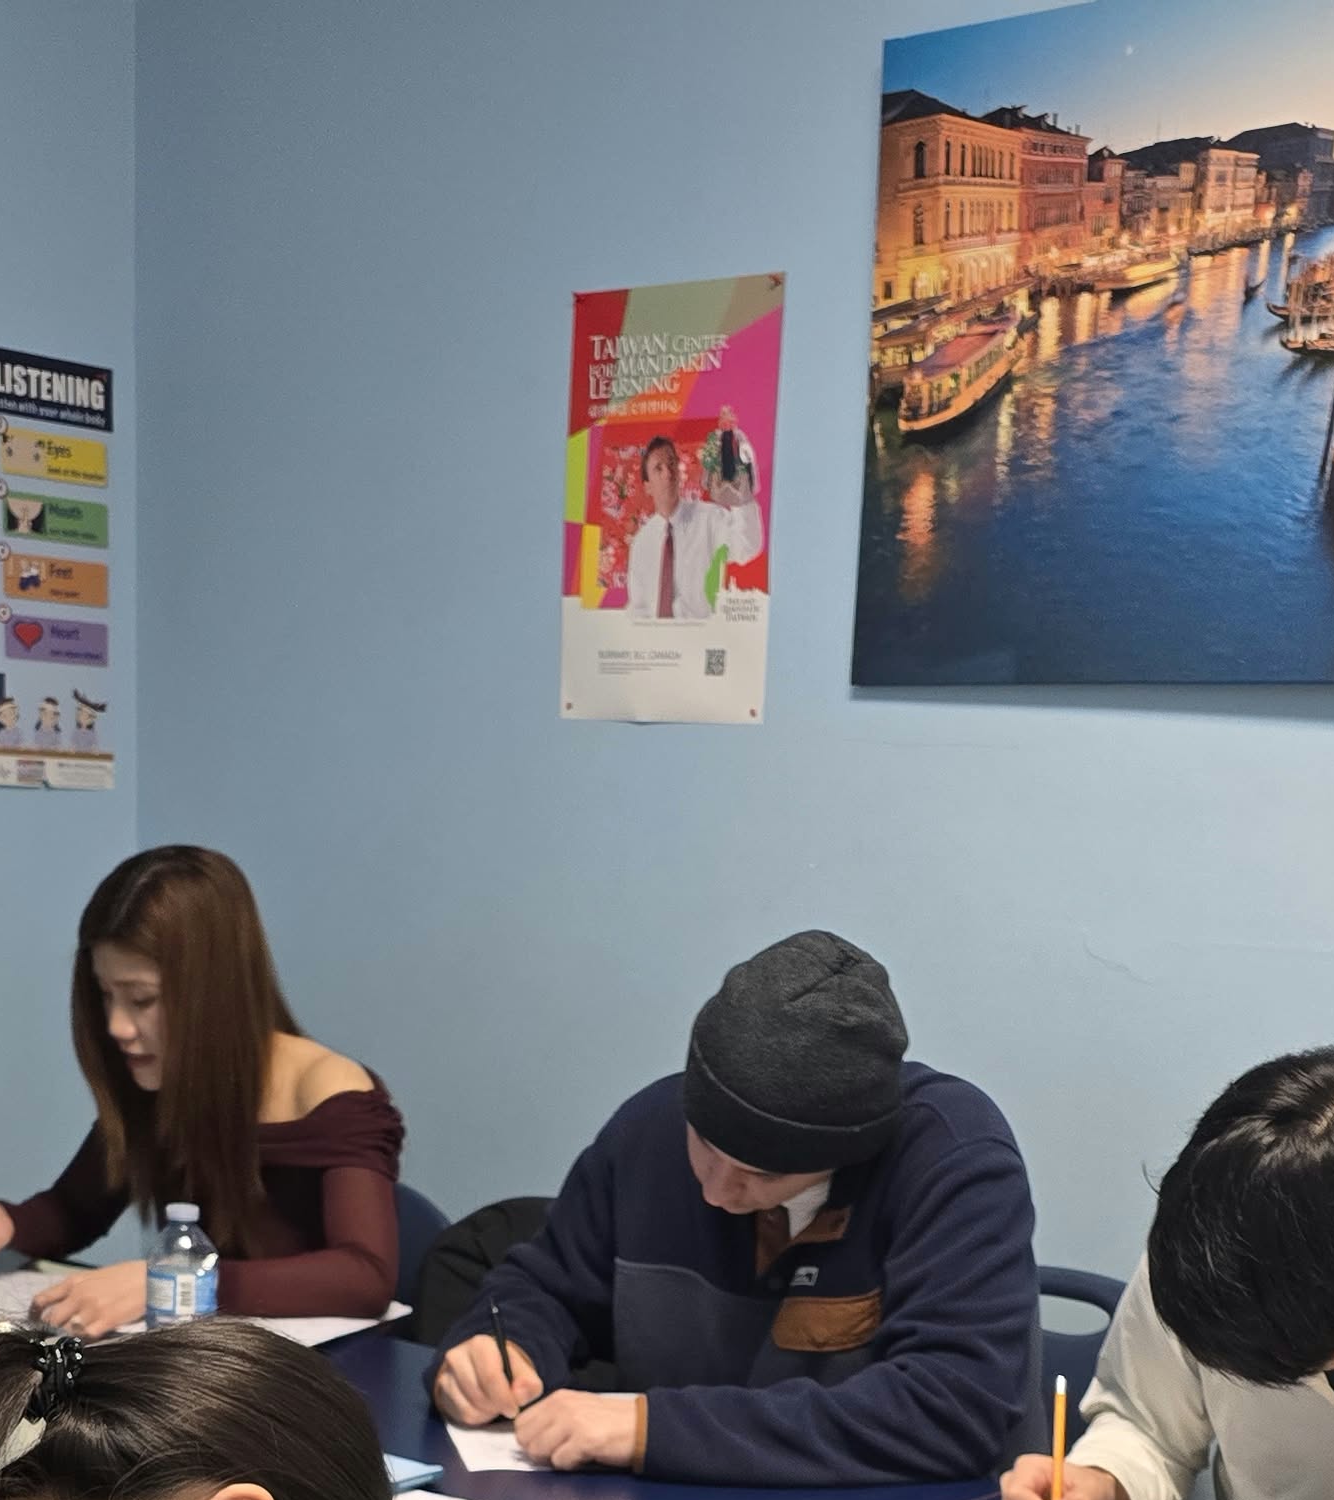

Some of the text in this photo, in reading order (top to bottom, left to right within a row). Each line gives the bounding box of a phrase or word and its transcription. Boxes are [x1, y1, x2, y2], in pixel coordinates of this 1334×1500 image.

[588, 333, 729, 361] TAIWAN CENTER
[617, 351, 723, 376] MANDARIN
[589, 374, 681, 400] LEARNING
